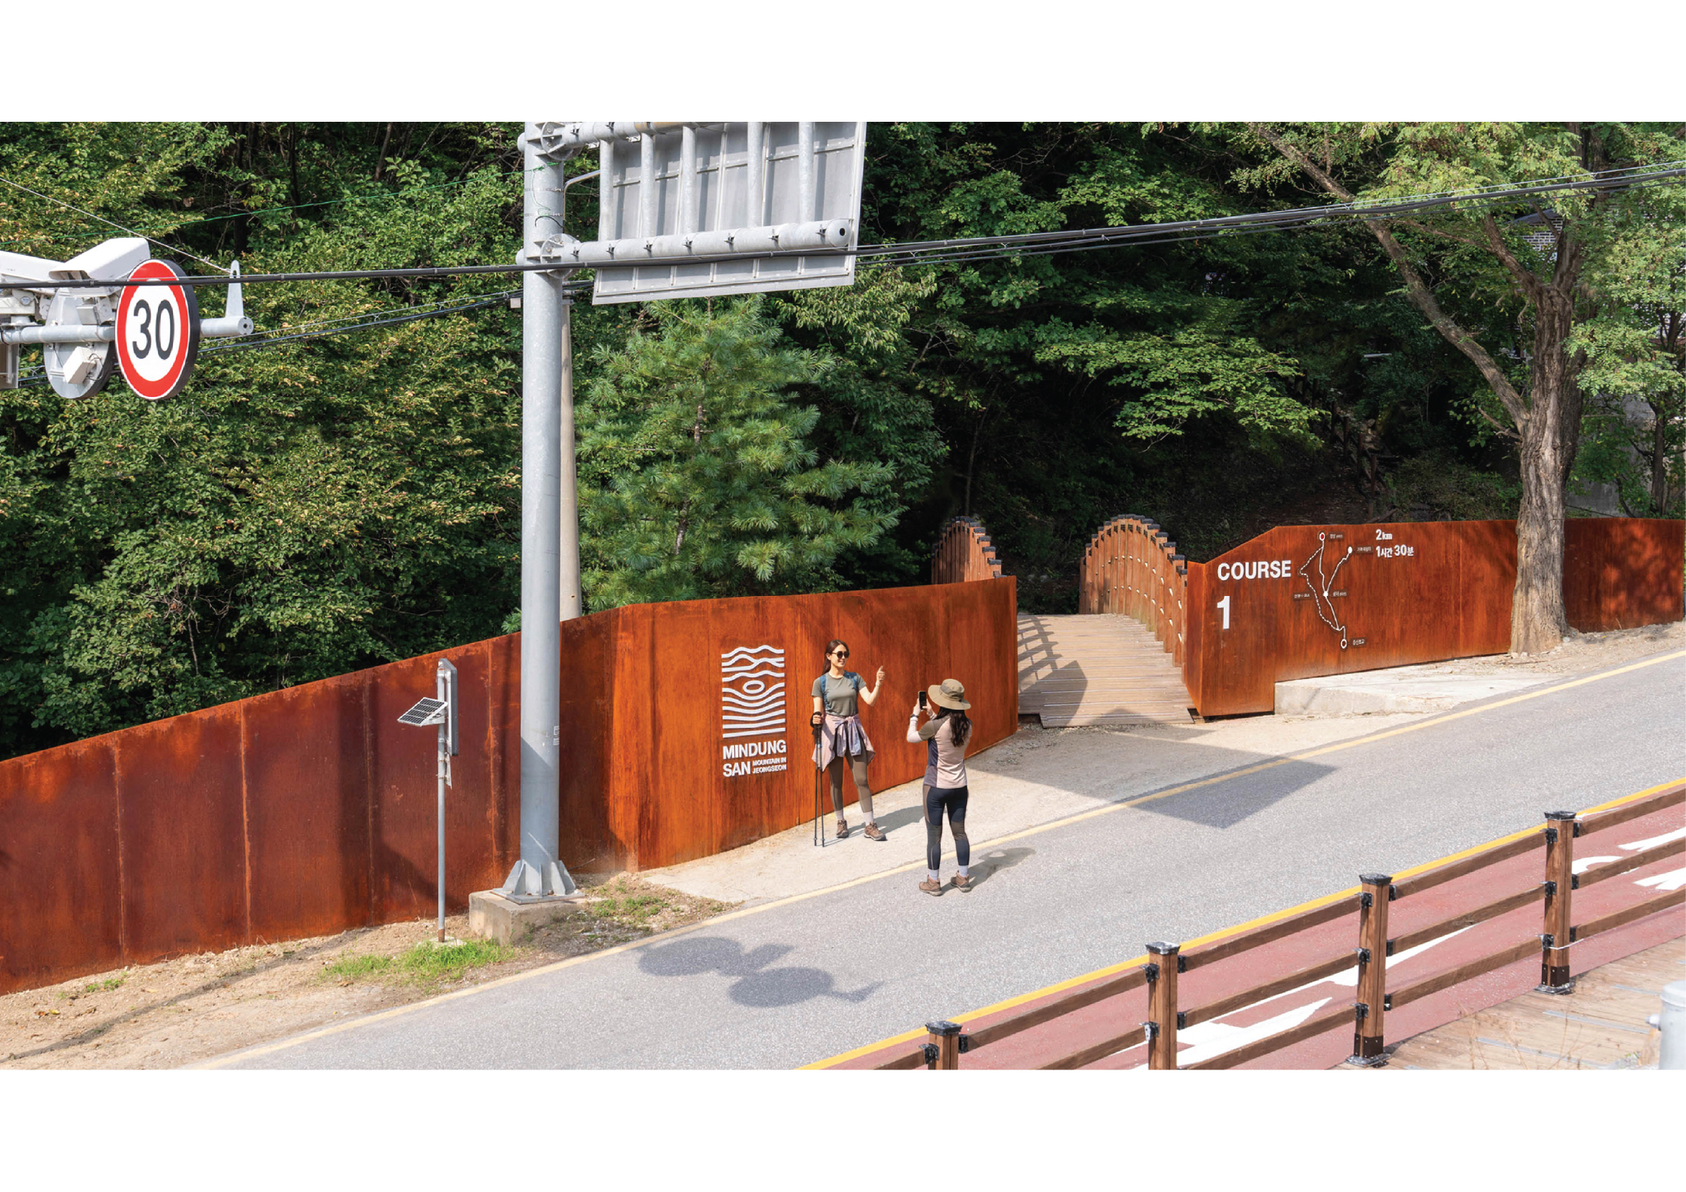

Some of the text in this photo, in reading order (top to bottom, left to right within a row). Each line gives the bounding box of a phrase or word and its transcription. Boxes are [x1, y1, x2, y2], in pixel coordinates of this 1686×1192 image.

[132, 299, 175, 360] 30
[1375, 529, 1393, 540] 2km
[1375, 545, 1393, 558] 1시간
[1394, 544, 1414, 556] 30분
[1217, 560, 1292, 581] COURSE
[1217, 595, 1230, 630] 1
[723, 739, 787, 760] MINDUNG
[723, 761, 751, 777] SAN
[752, 758, 780, 766] MOUNTAIN
[752, 764, 787, 774] JEONGSEON
